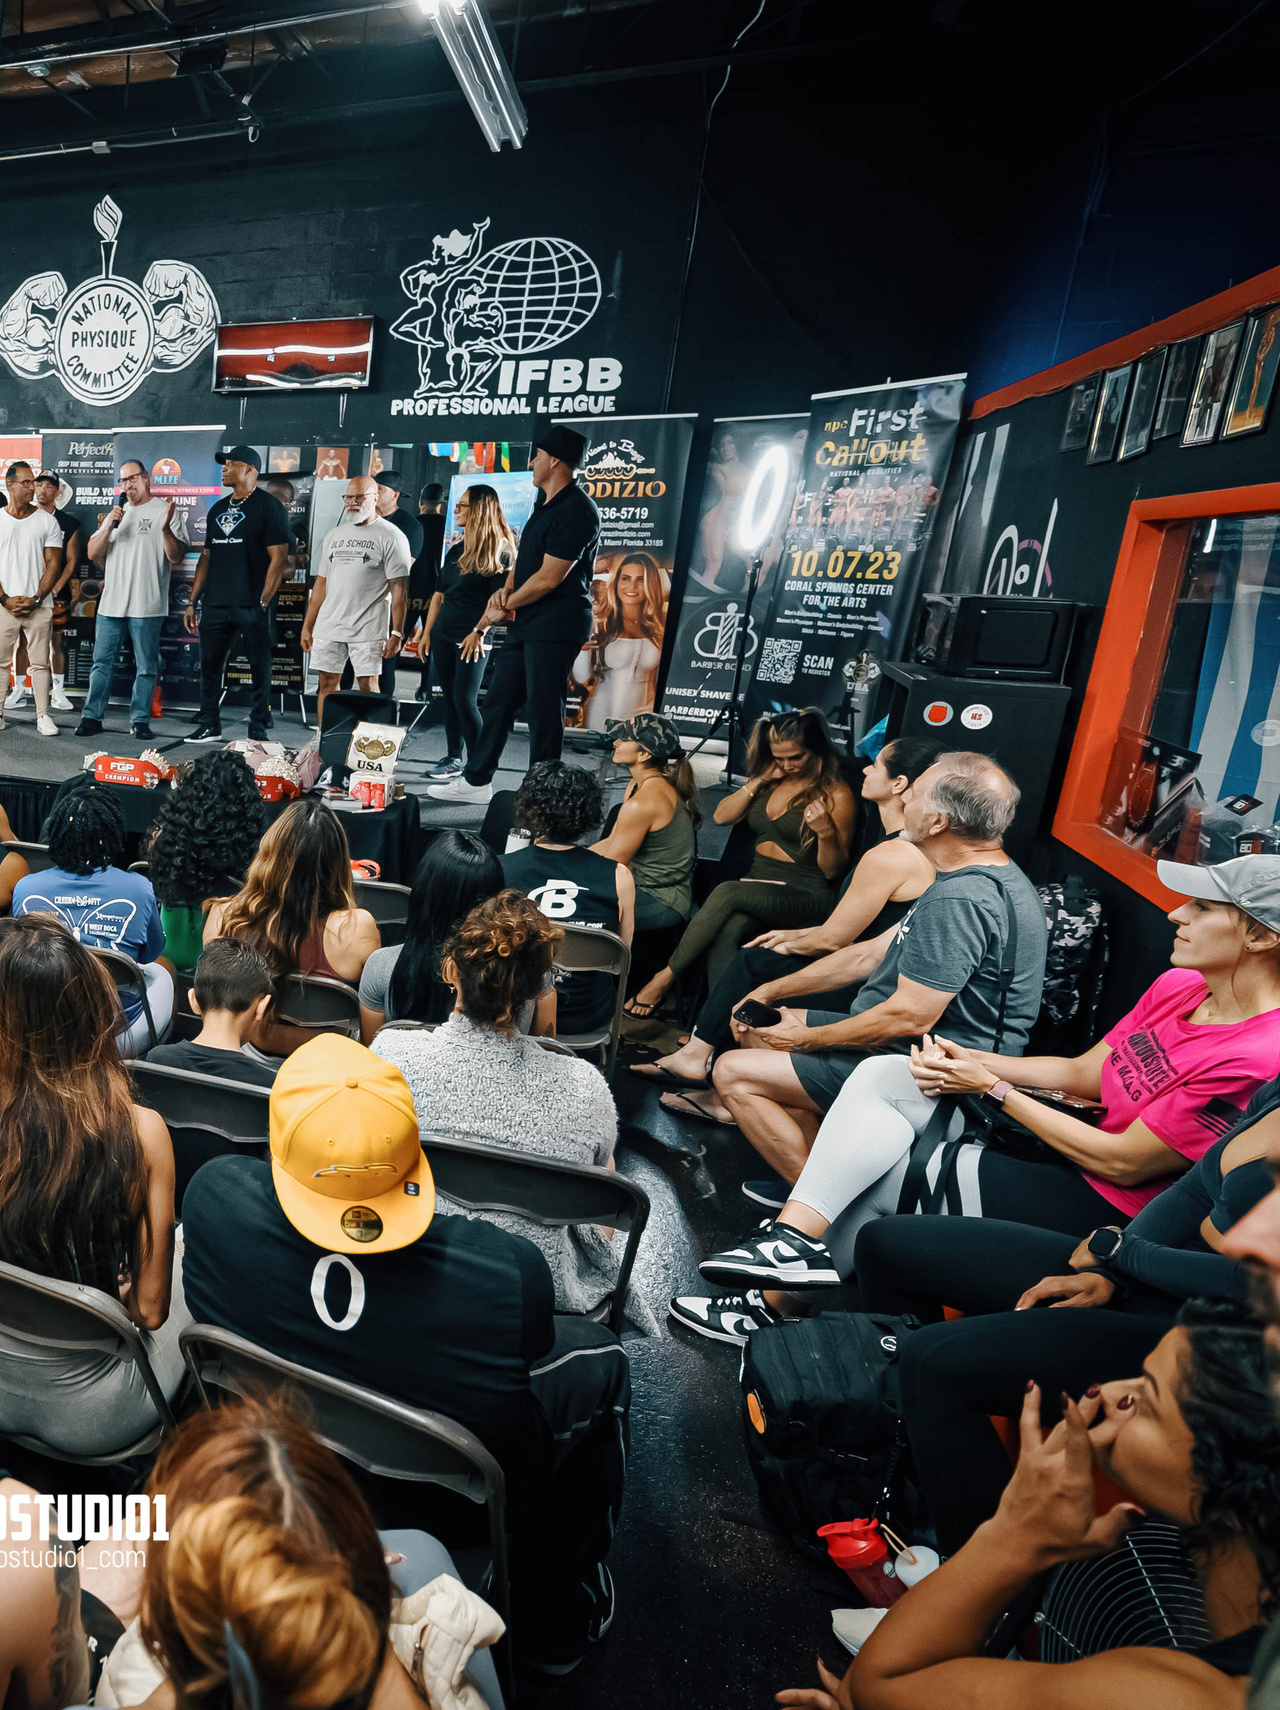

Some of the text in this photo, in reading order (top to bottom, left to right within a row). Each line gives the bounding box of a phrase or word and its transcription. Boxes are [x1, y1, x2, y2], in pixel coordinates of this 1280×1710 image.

[71, 293, 139, 325] NATIONAL
[72, 330, 137, 349] PHYSIQUE
[66, 352, 139, 389] COMMITTEE
[497, 358, 622, 396] IFBB
[390, 395, 616, 416] PROFESSIONAL LEAGUE
[824, 401, 927, 437] npc First
[815, 433, 928, 467] Callout
[58, 460, 70, 468] SKIP
[829, 467, 902, 478] NATIONAL QUALIFIER
[76, 487, 115, 496] BUILD YO
[75, 496, 114, 506] PERFECT
[600, 521, 655, 529] odizio@gmail.com
[330, 539, 376, 550] OLD SCHOOL
[604, 539, 622, 547] Miami
[622, 539, 644, 547] Florida
[790, 550, 902, 580] 10.07.23
[784, 580, 894, 596] CORAL SPRINGS CENTER
[802, 594, 868, 608] FOR THE ARTS
[802, 654, 835, 670] SCAN
[665, 687, 698, 697] UNISEX
[110, 761, 135, 771] FGP
[357, 760, 383, 772] USA
[104, 774, 140, 783] CHAMPION
[89, 923, 118, 932] WEST BOCA
